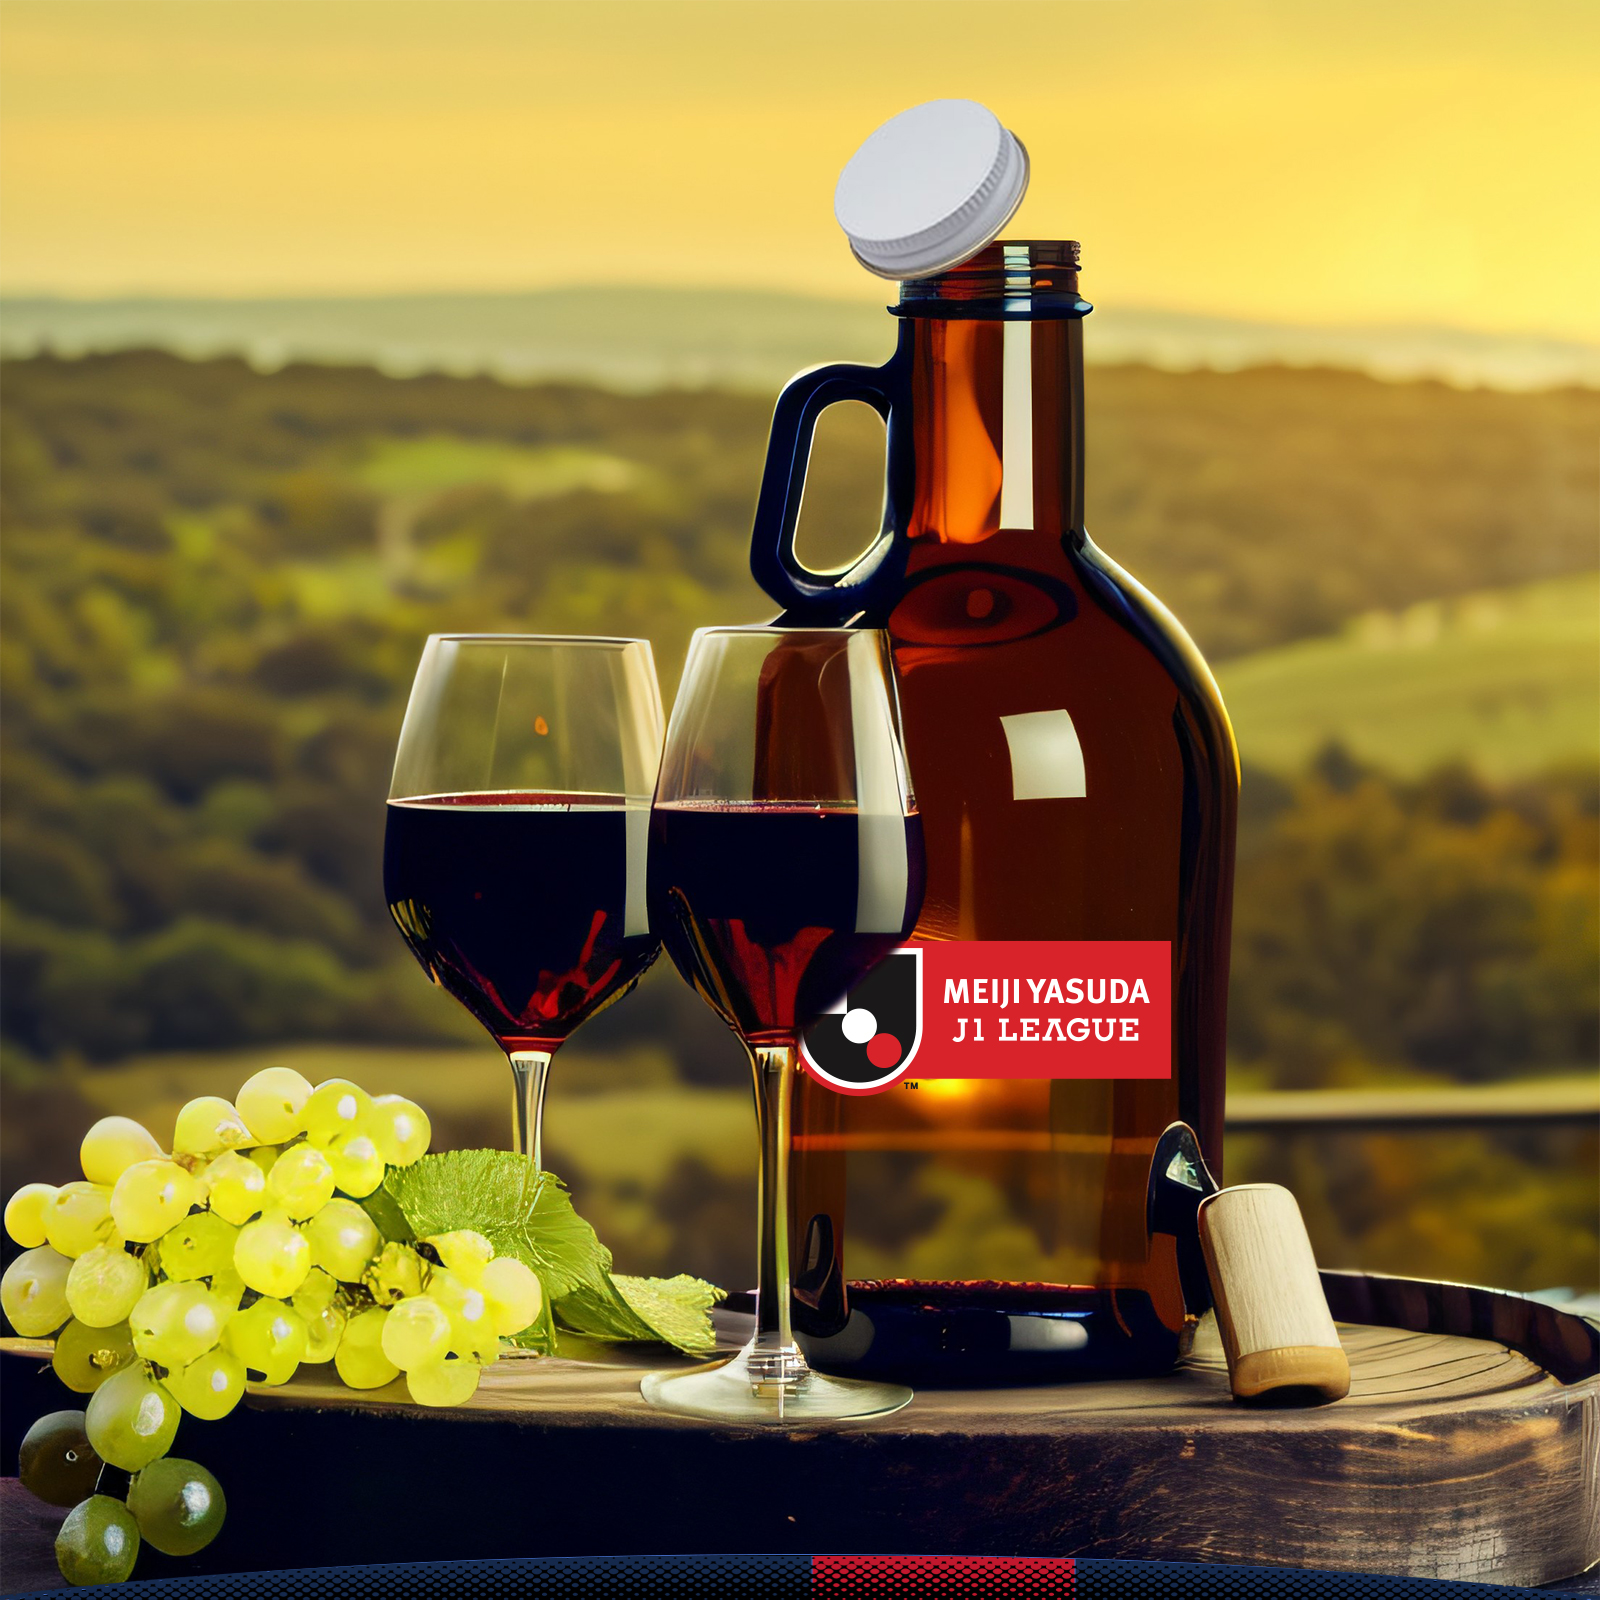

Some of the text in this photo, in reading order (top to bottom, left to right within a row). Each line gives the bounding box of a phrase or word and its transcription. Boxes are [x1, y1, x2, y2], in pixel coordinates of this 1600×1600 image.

[943, 978, 1151, 1009] MEIJI YASUDA
[952, 1018, 1140, 1043] J1 LEAGUE
[903, 1082, 919, 1090] TM
